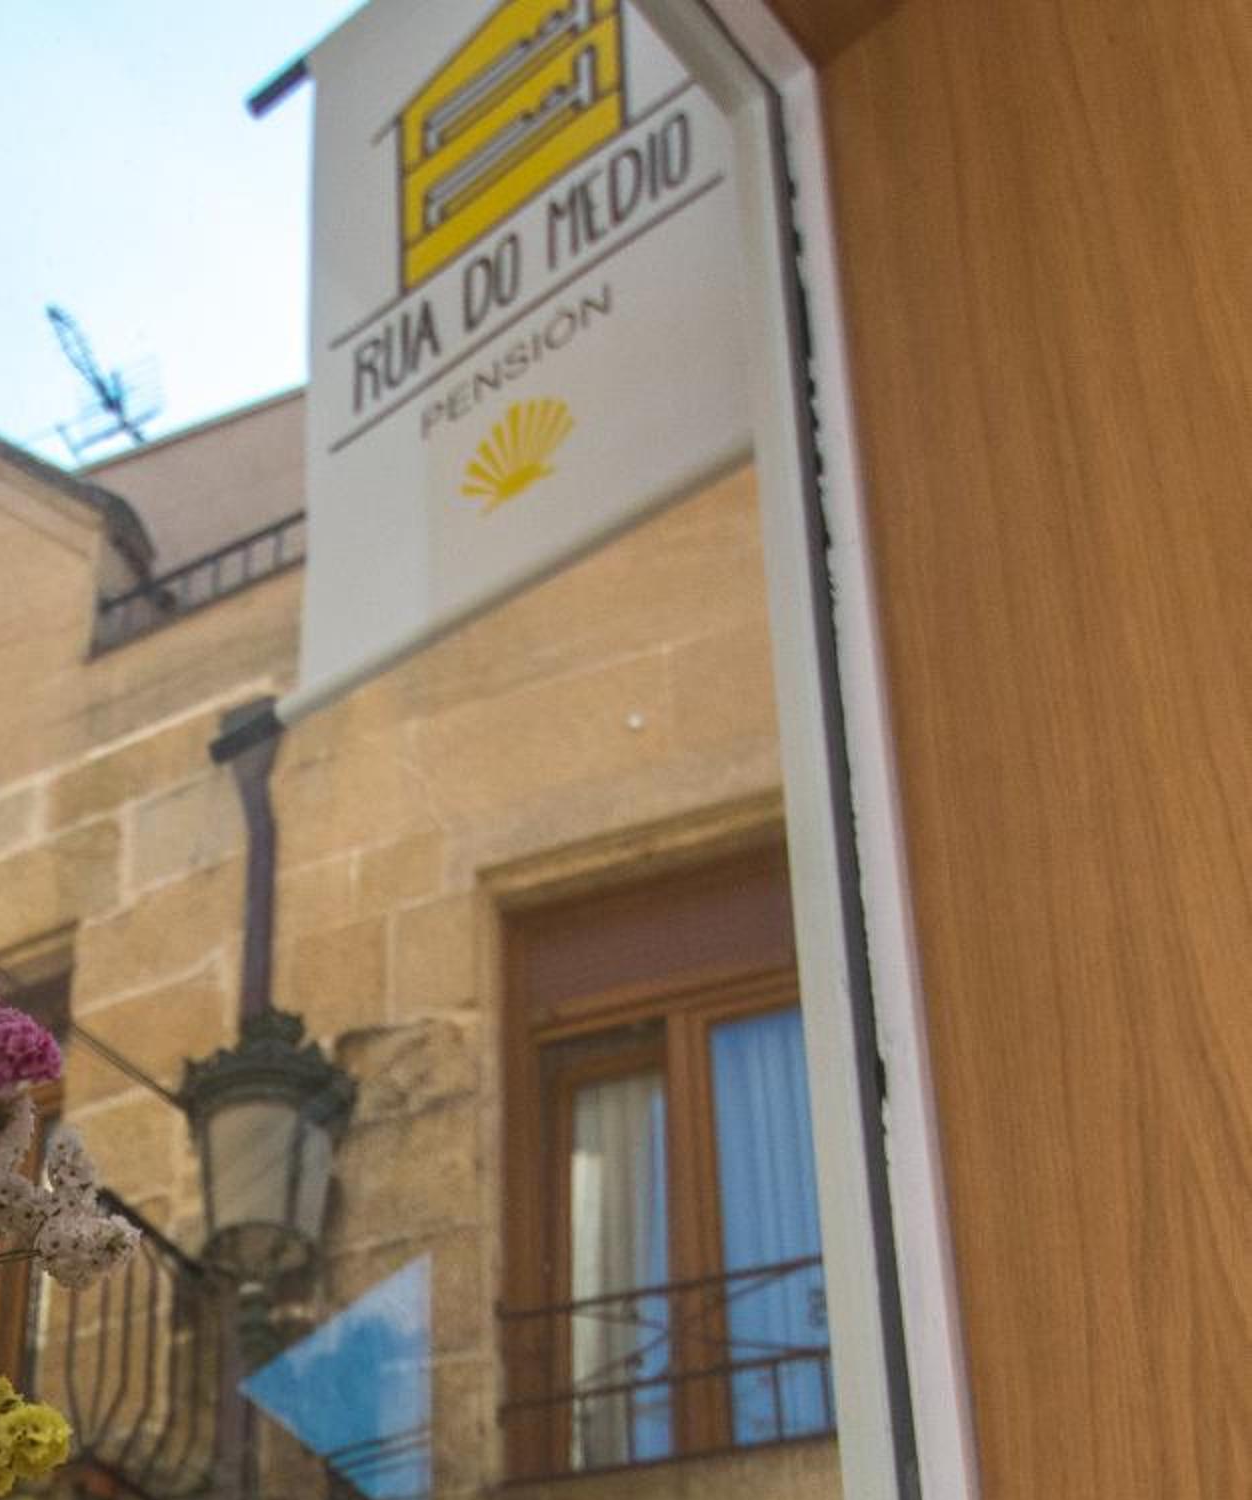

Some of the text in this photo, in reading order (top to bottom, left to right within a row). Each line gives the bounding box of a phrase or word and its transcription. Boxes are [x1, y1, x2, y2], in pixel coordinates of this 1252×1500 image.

[353, 112, 691, 412] RUA DO MEDIO
